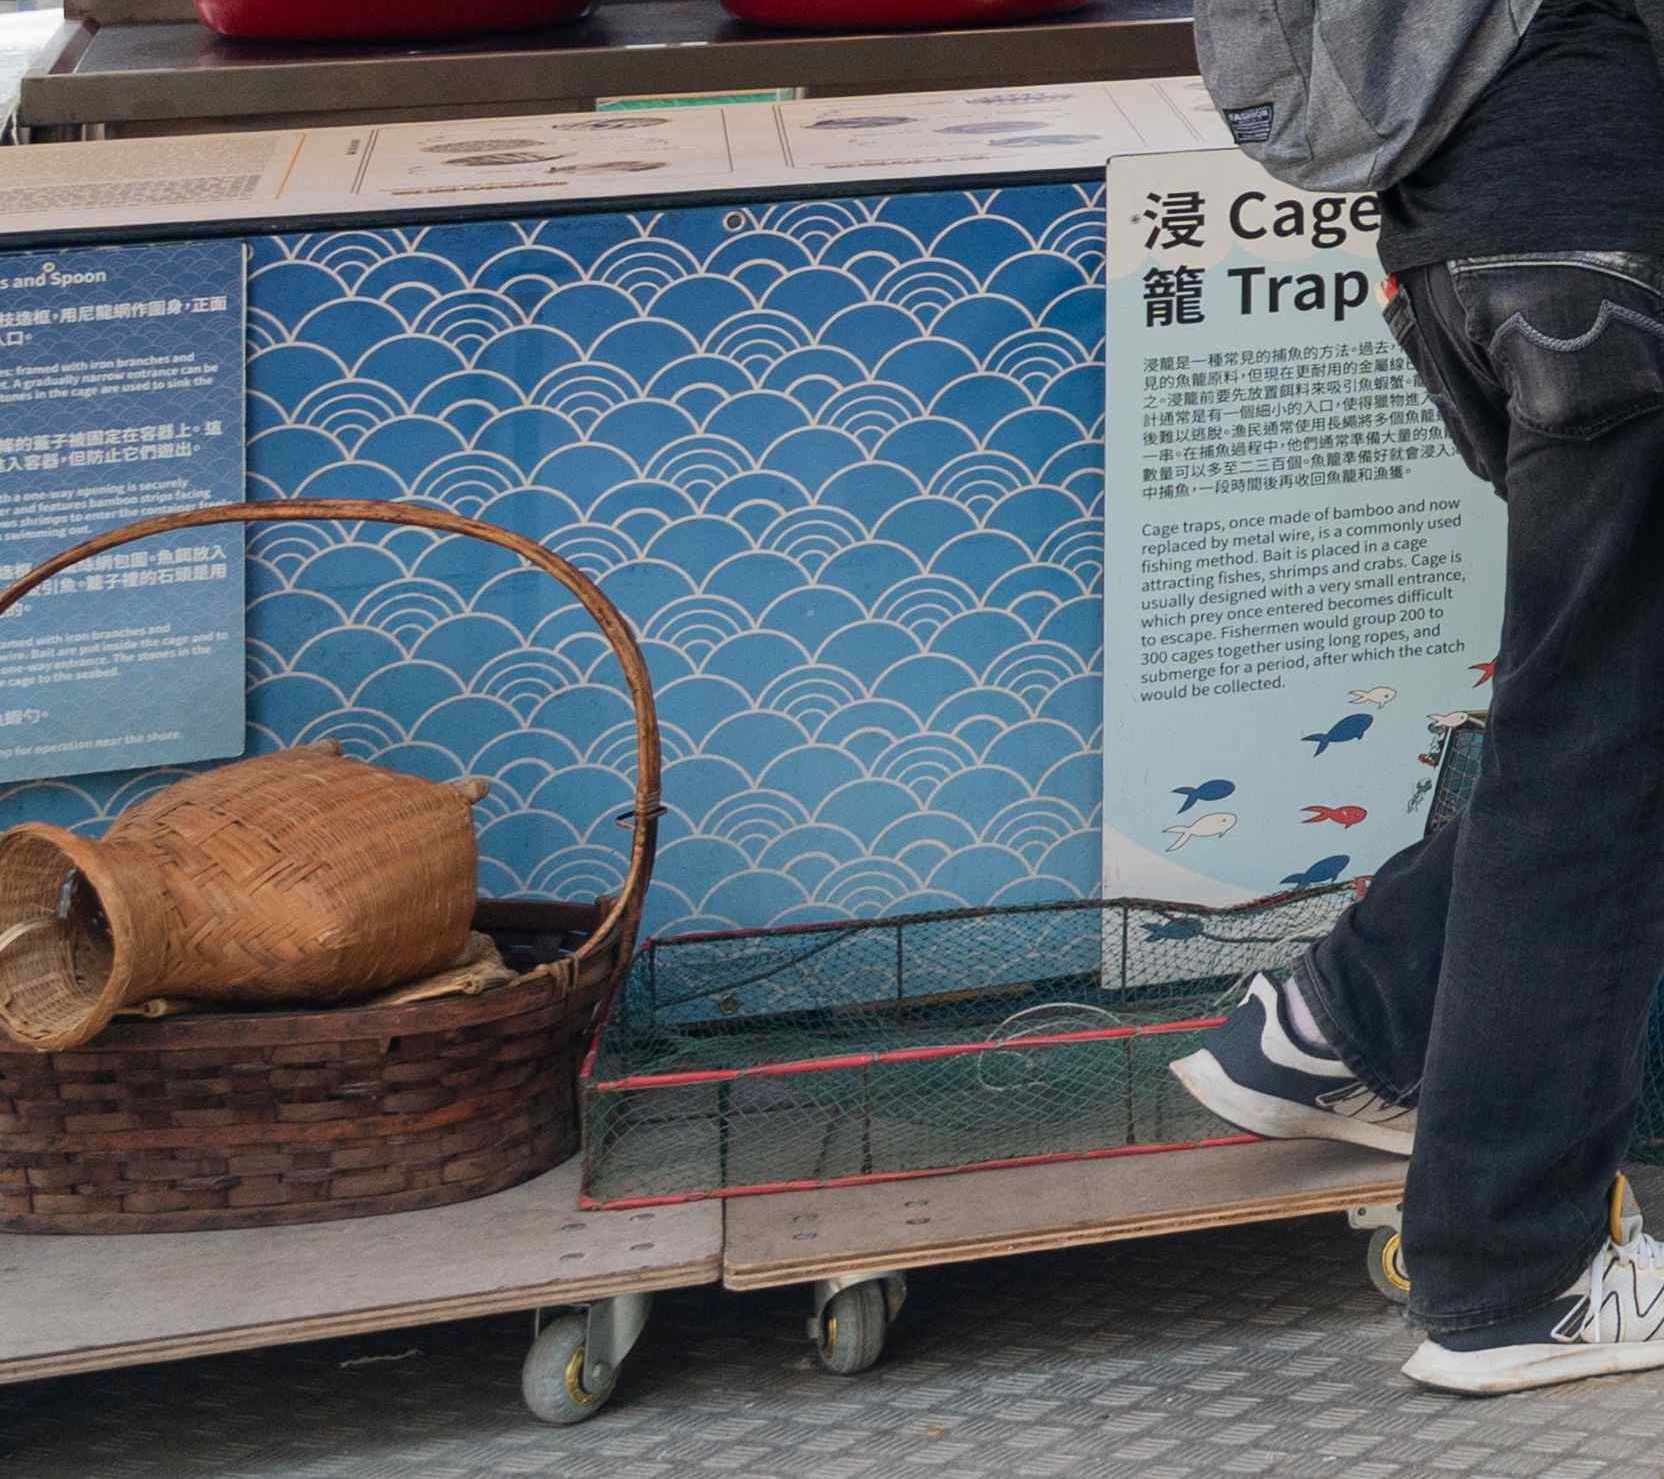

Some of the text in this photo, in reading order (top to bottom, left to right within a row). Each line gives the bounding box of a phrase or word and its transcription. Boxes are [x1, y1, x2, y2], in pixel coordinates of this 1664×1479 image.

[1229, 190, 1381, 249] Cage
[13, 270, 107, 290] and Spoon
[1227, 266, 1370, 322] Trap
[1141, 499, 1461, 538] Cage traps, once made of bamboo and now
[1141, 514, 1464, 561] replaced by metal wire, is a commonly used
[1141, 539, 1427, 573] fishing method. Bait is placed in a cage
[1141, 551, 1462, 594] attracting fishes, shrimps and crabs. Cage is
[1141, 571, 1468, 610] usually designed with a very small entrance,
